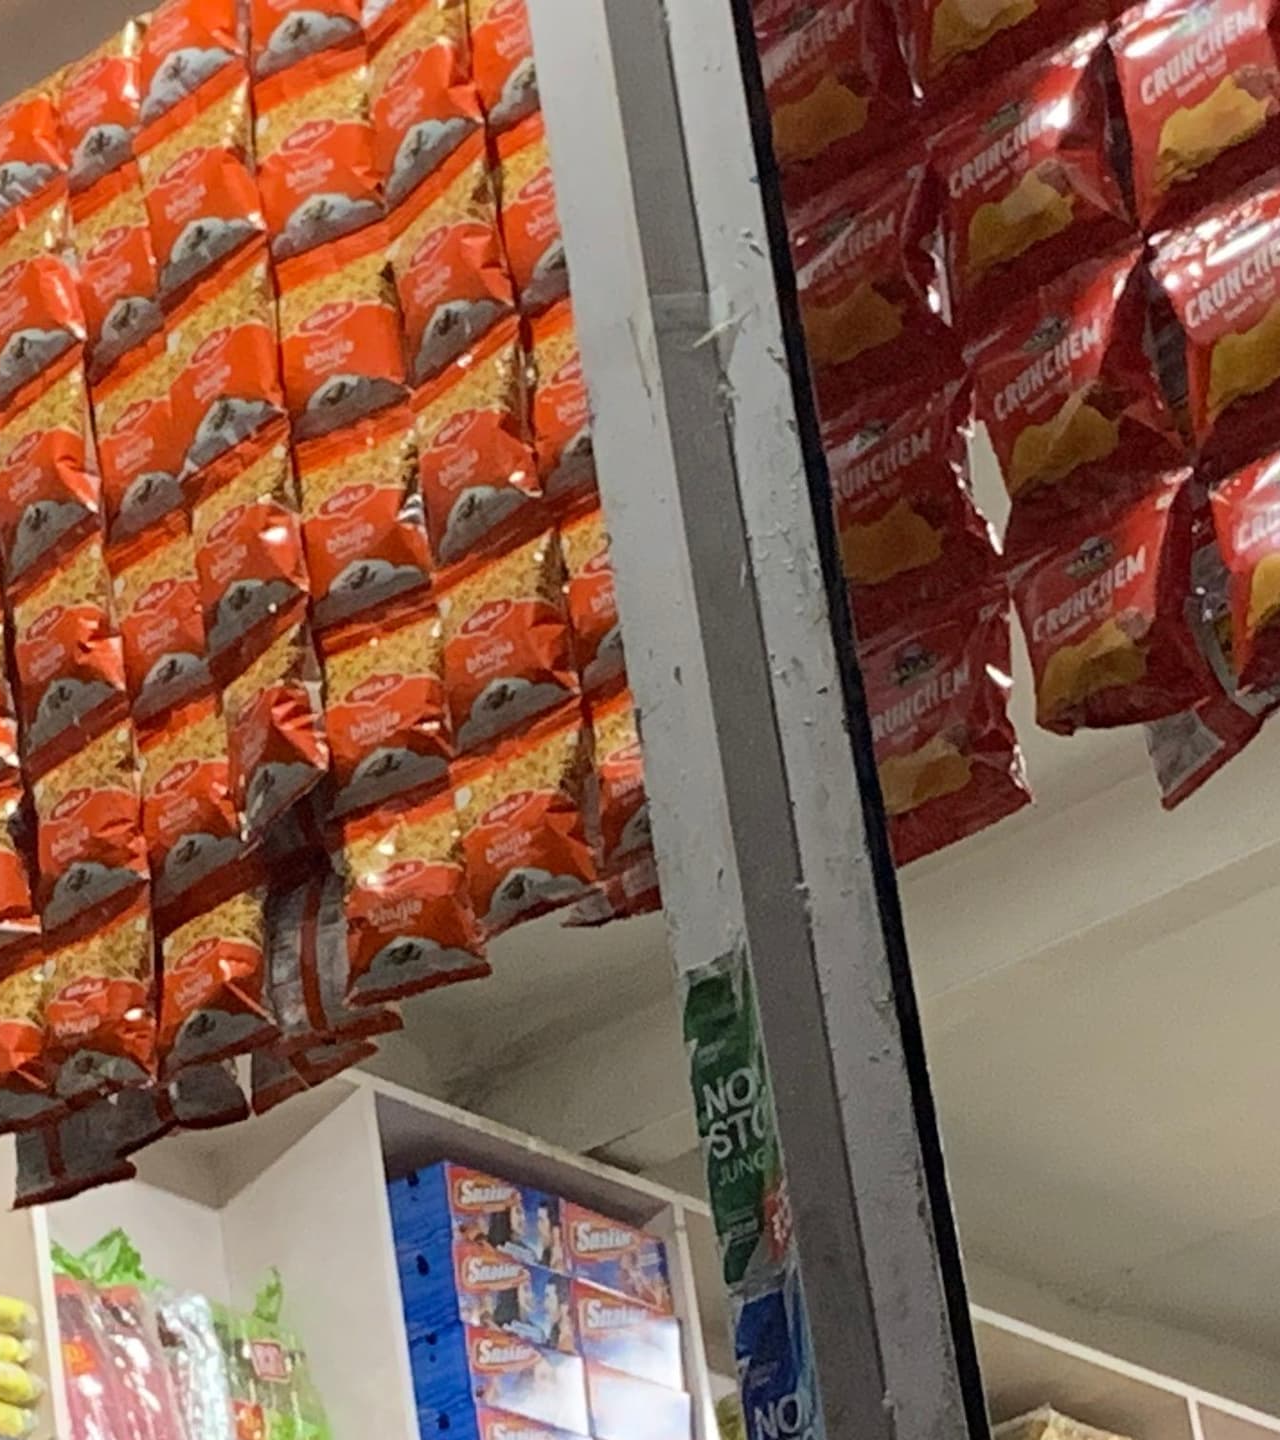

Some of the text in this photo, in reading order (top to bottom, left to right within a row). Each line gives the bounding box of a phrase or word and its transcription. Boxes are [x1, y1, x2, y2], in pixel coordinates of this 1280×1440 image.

[1141, 3, 1259, 105] CRUNCHEM
[949, 103, 1065, 197] CRUNCHE
[995, 322, 1103, 420] CRUNCHEM
[1033, 547, 1145, 642] CRUNCHEM
[873, 665, 970, 741] RUNCHEM
[703, 1067, 762, 1120] NO
[718, 1147, 773, 1188] JUNG
